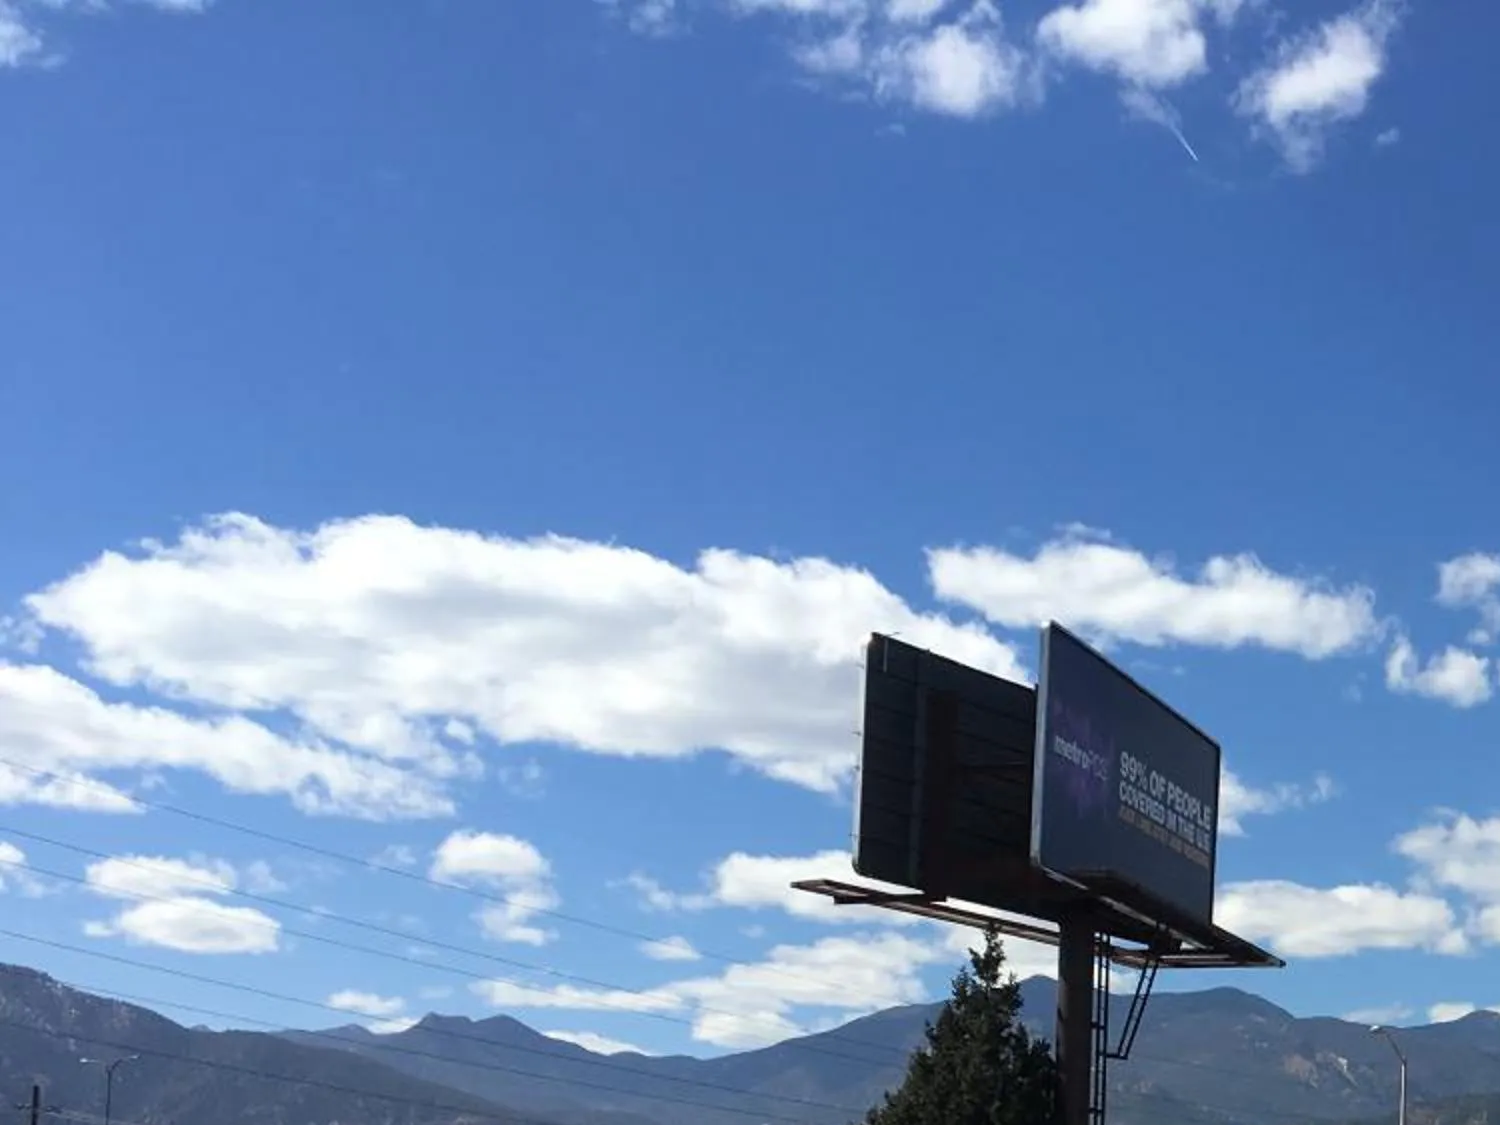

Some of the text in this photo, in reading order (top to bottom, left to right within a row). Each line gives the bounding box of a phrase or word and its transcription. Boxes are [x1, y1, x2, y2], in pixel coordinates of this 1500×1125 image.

[1119, 780, 1165, 825] COVERED
[1120, 751, 1211, 830] 99% OF PEOPLE
